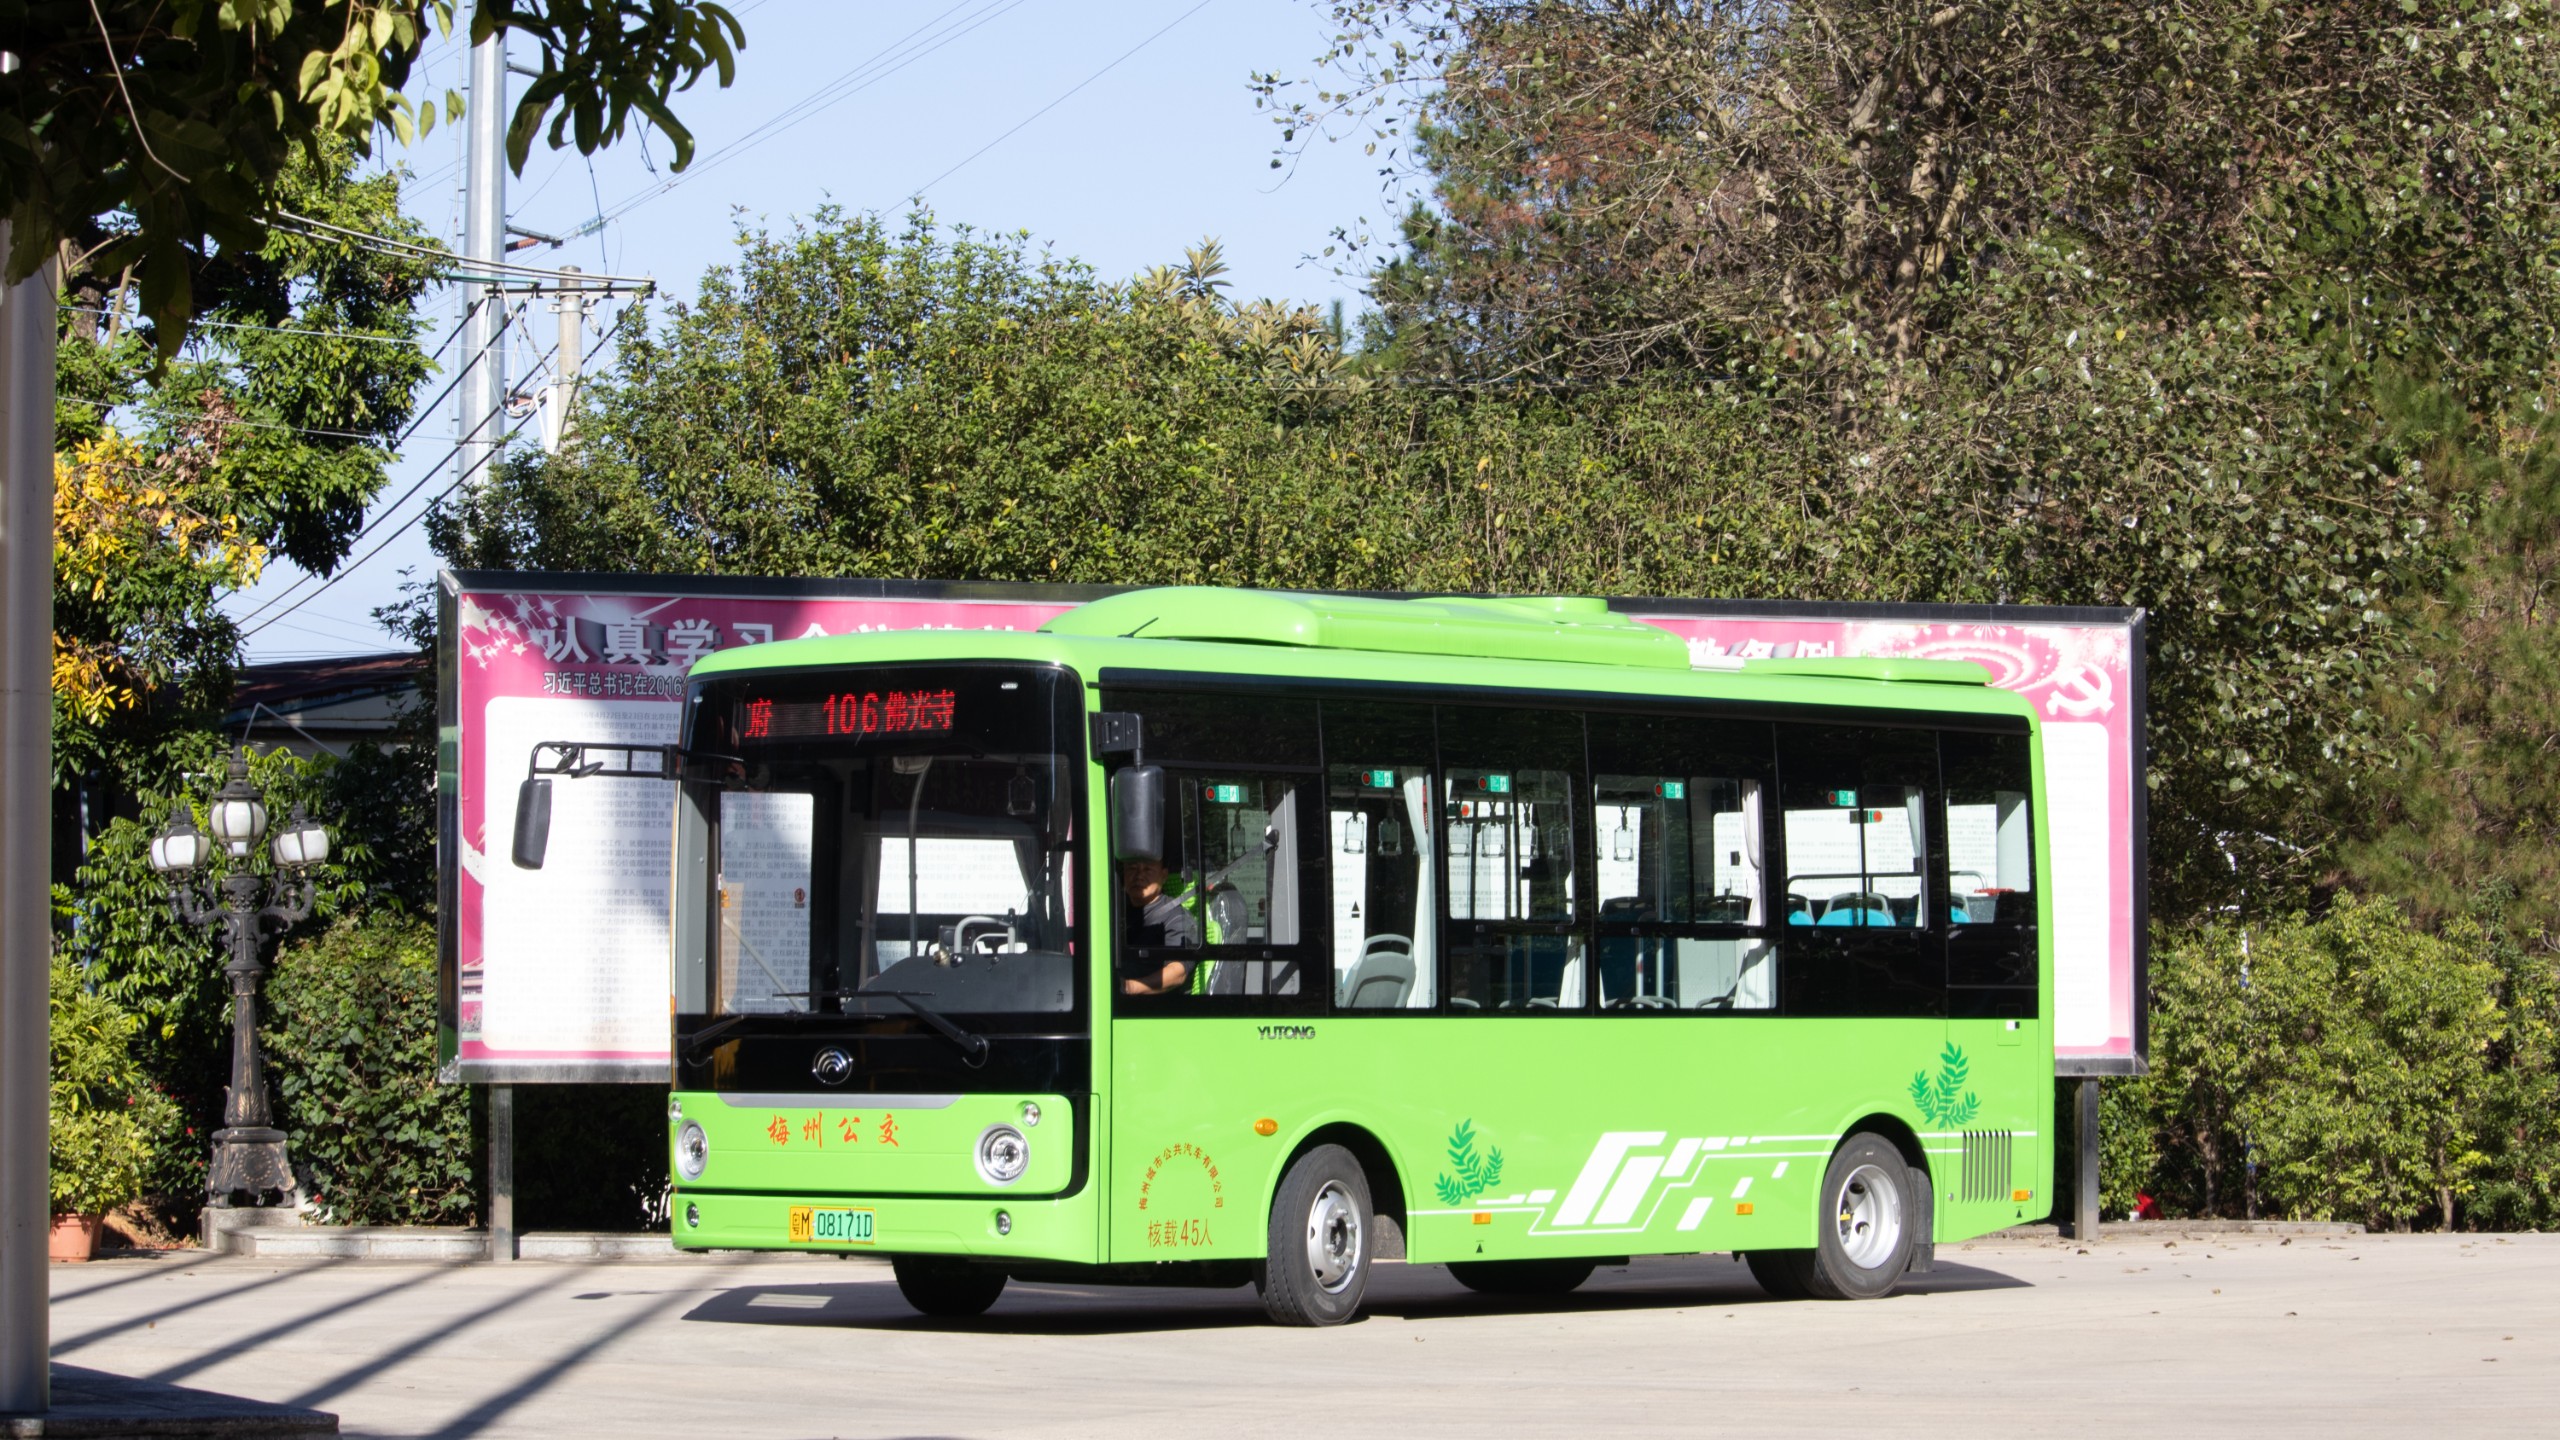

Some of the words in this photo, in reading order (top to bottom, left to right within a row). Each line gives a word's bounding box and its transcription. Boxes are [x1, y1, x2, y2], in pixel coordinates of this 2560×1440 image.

[543, 672, 688, 697] 习近平总书记在2016
[745, 698, 773, 738] 府
[1257, 1026, 1316, 1040] YUTONG
[767, 1111, 899, 1149] 梅州公交
[1148, 1218, 1213, 1248] 核载45人
